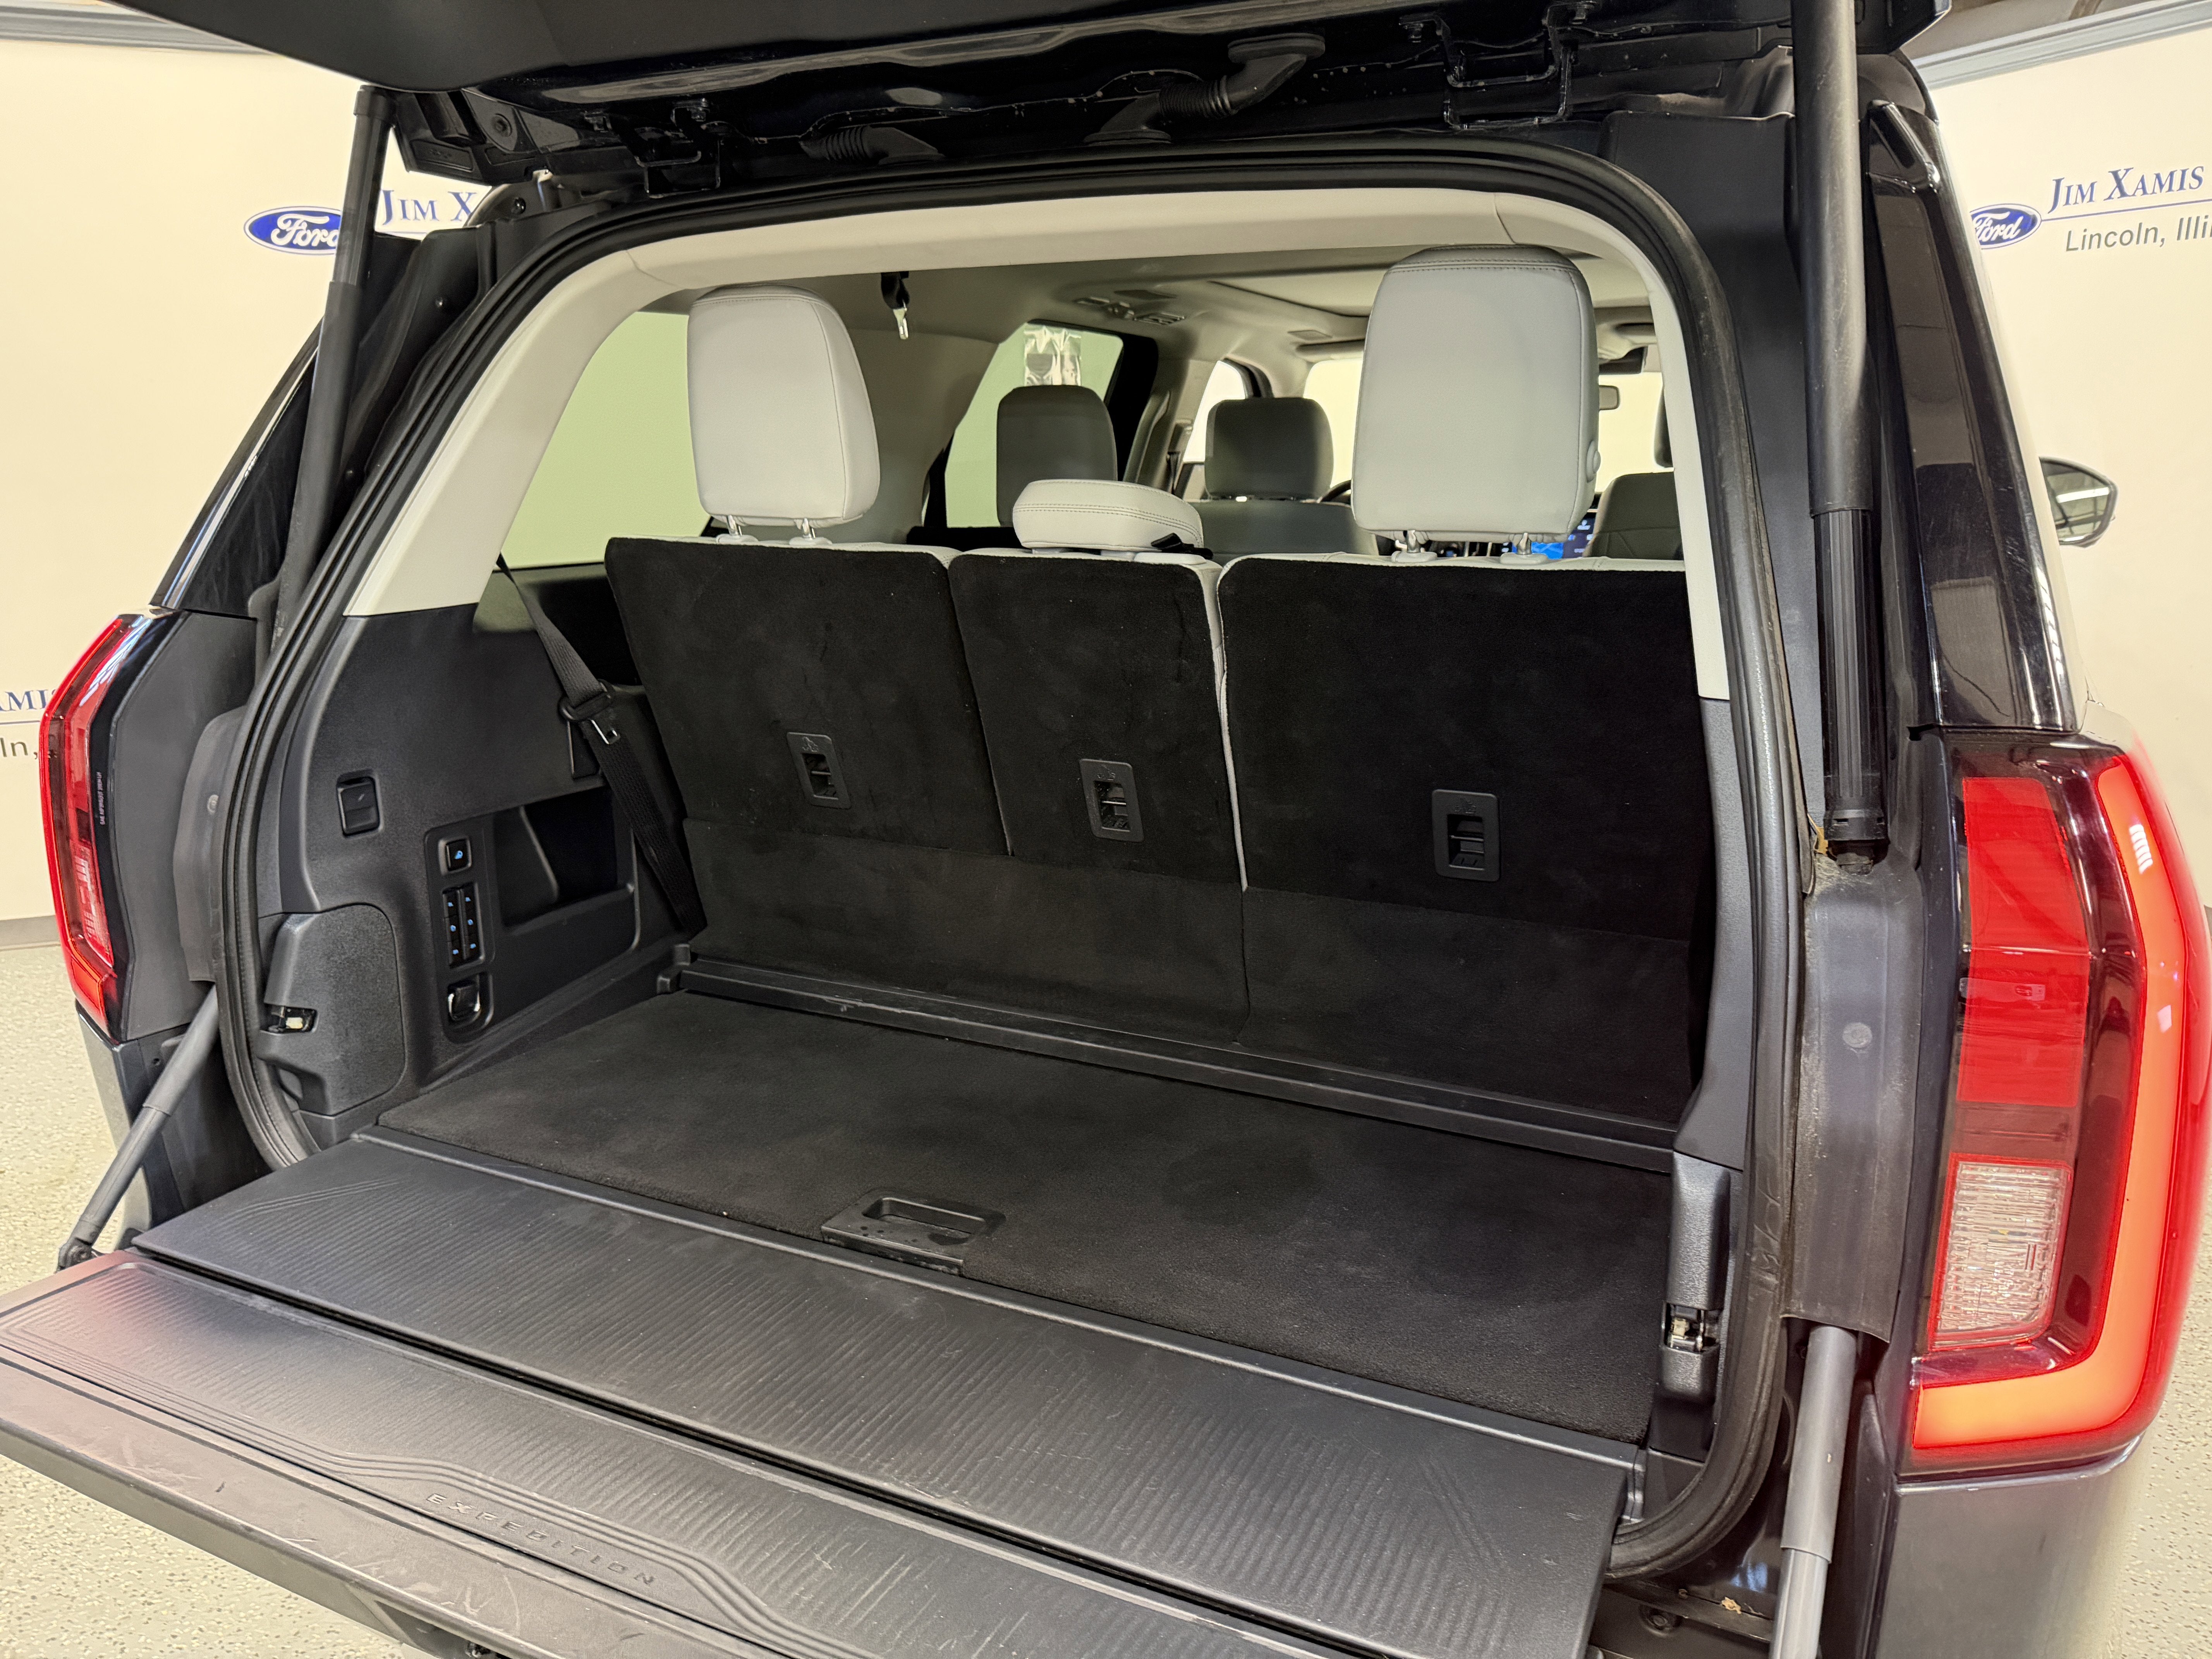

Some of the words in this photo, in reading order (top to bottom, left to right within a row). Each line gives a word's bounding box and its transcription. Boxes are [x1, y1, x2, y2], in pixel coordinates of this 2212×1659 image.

[2104, 166, 2204, 201] XAMIS
[2066, 222, 2165, 252] Lincoln,
[2176, 215, 2212, 241] Illi
[426, 1493, 655, 1585] EXPEDITION
